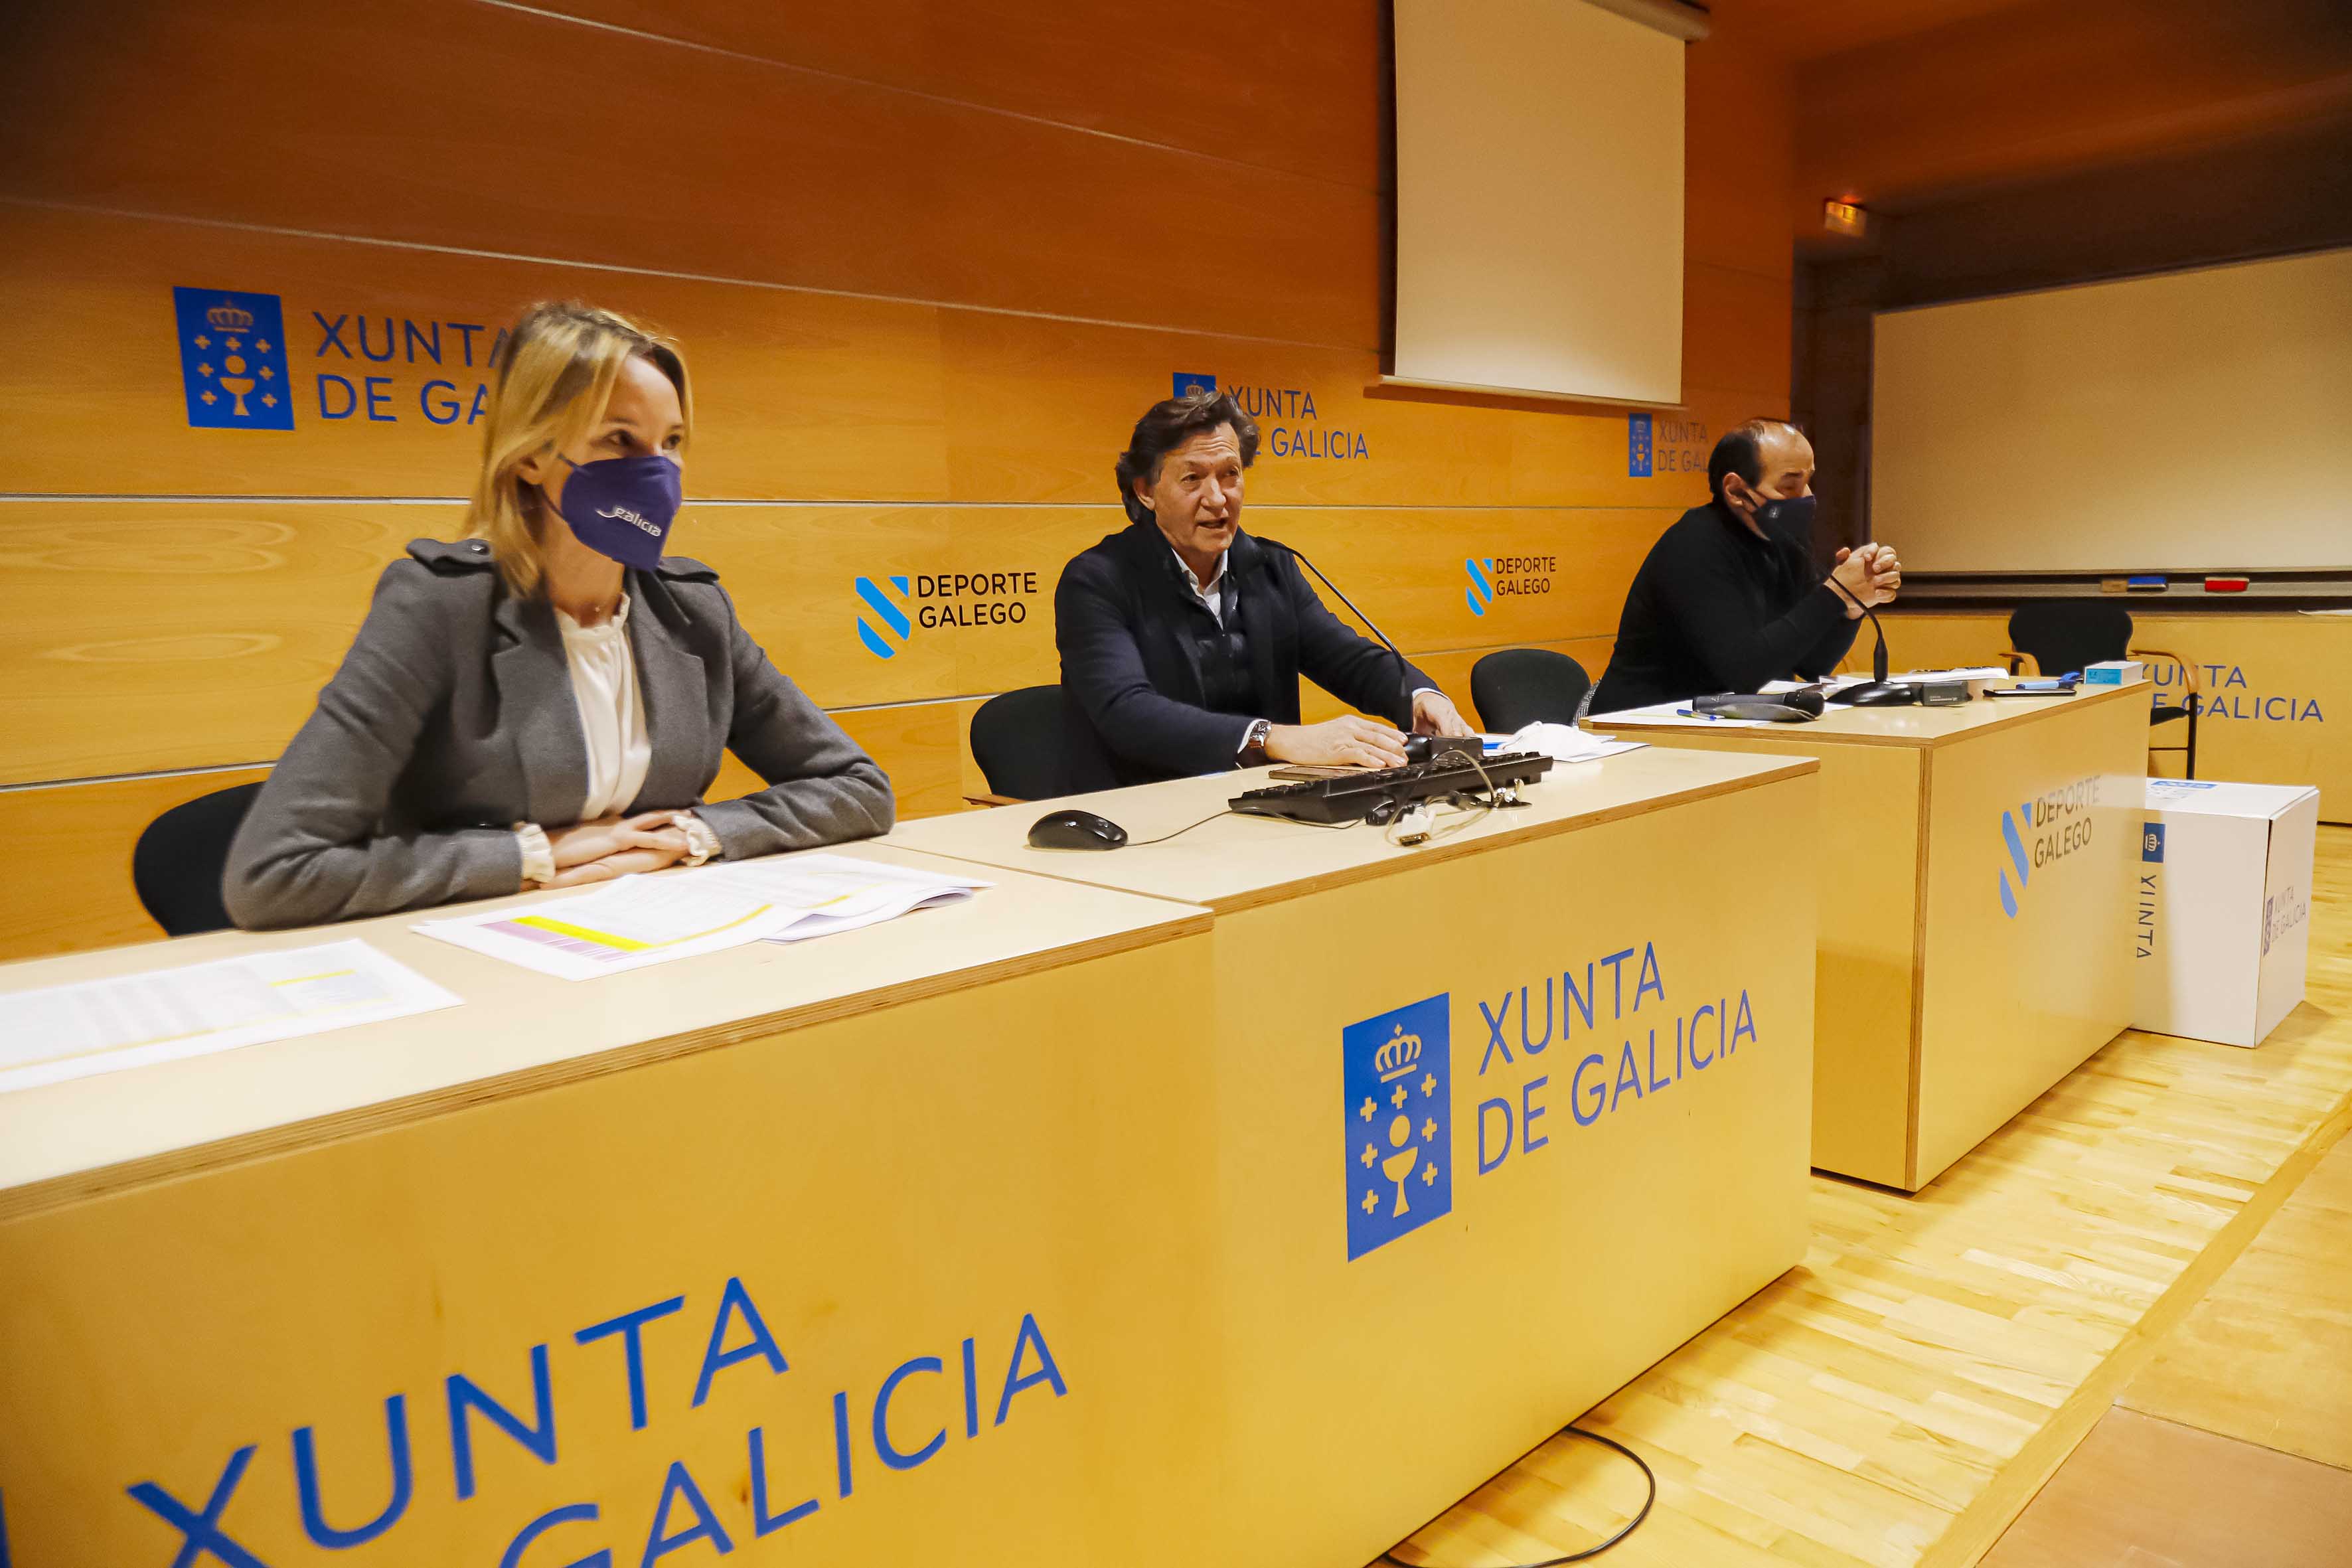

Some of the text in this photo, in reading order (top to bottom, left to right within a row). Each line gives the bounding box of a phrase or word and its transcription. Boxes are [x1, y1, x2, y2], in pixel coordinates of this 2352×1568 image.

[317, 374, 397, 422] DE
[1229, 385, 1317, 420] XUNTA
[1271, 427, 1369, 459] GALICIA
[1659, 420, 1708, 443] XUNTA
[1658, 449, 1677, 472] DE
[1496, 556, 1557, 574] DEPORTE
[917, 572, 1038, 597] DEPORTE
[1496, 578, 1551, 596] GALEGO
[919, 601, 1026, 629] GALEGO
[2036, 775, 2101, 828] DEPORTE
[2034, 817, 2092, 868] GALEGO
[1478, 941, 1665, 1076] XUNTA
[1478, 989, 1757, 1176] DE GALICIA
[125, 1276, 790, 1568] XUNTA
